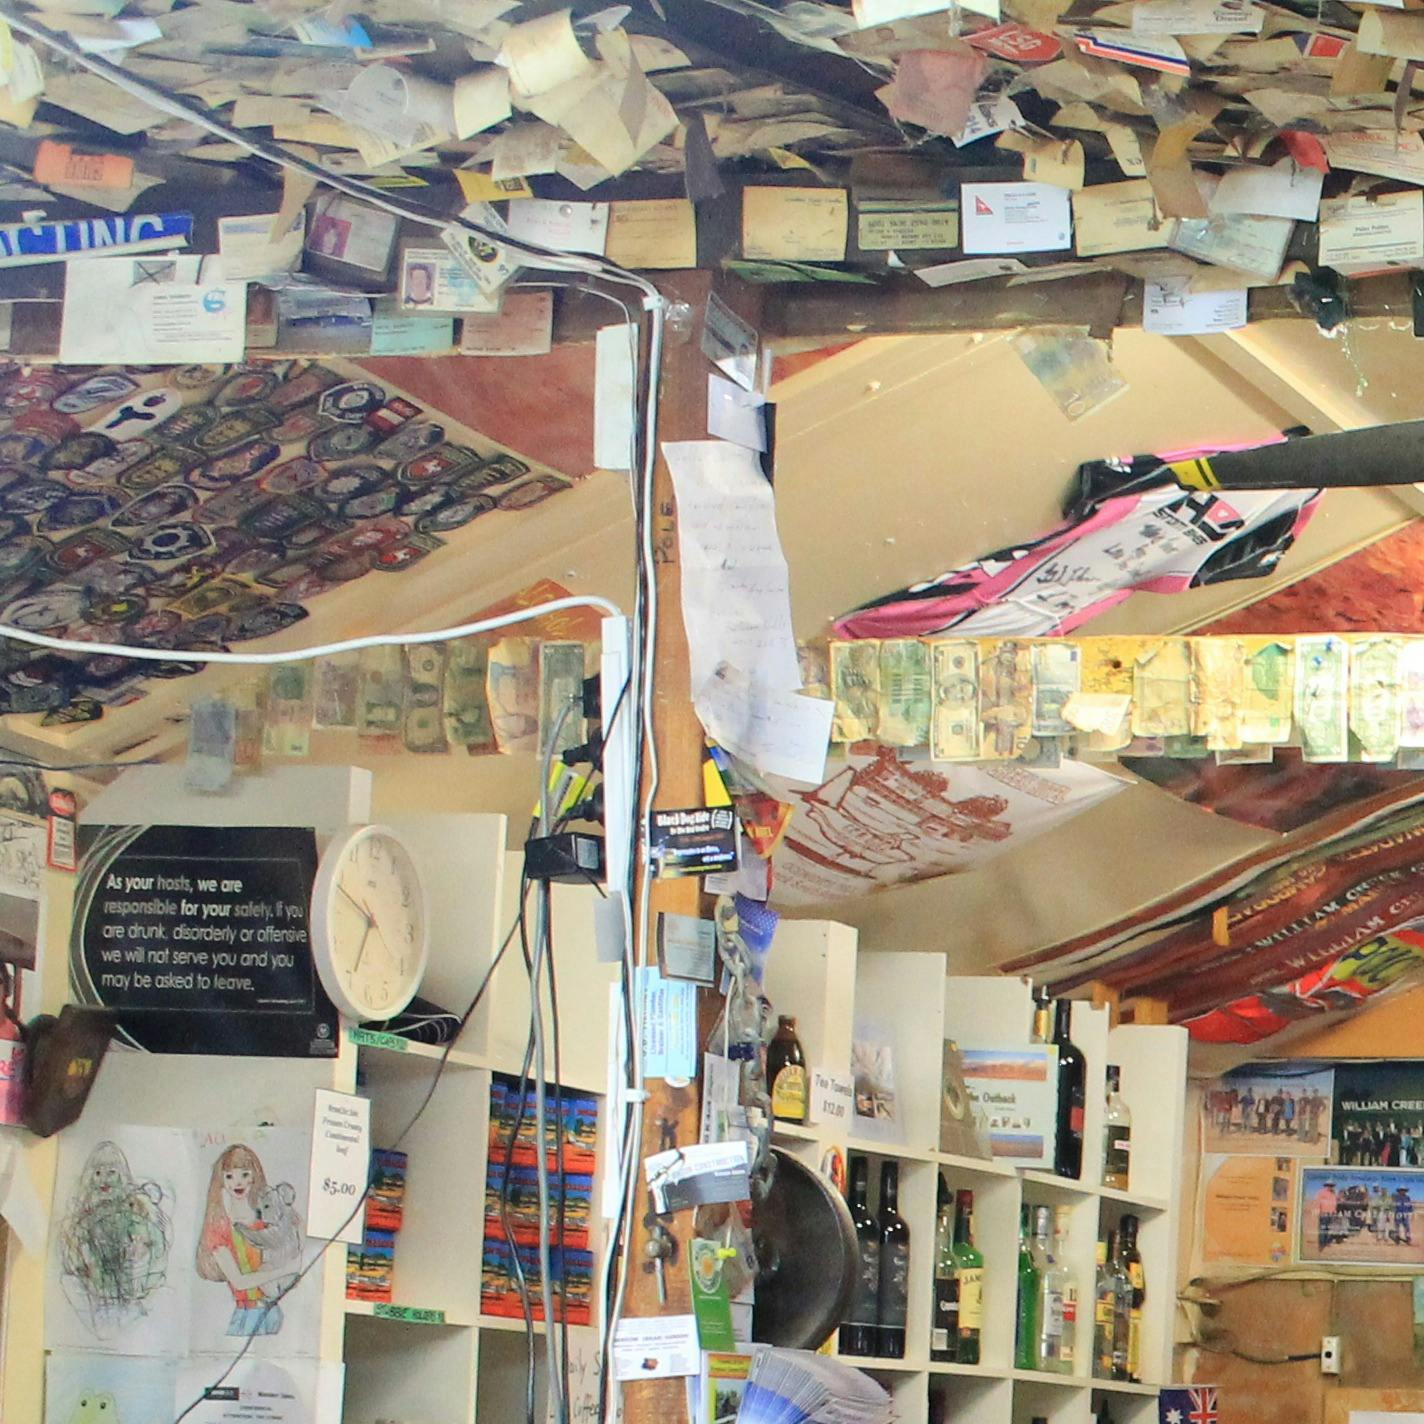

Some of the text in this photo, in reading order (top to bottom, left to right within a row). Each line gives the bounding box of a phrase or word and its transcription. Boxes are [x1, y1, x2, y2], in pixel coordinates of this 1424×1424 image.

[107, 874, 243, 893] As your hosts, we are
[104, 898, 303, 921] responsible for your safety. If you
[103, 926, 125, 939] are
[173, 923, 236, 945] disorderly
[240, 930, 254, 943] or
[257, 926, 308, 944] offensive
[1255, 901, 1342, 950] WILLIAM
[1286, 916, 1384, 970] WILLIAM
[102, 948, 295, 970] we will not serve you and you
[101, 972, 255, 992] may be asked to leave.
[1341, 1100, 1390, 1112] WILLIAM
[322, 1178, 356, 1196] $5.00
